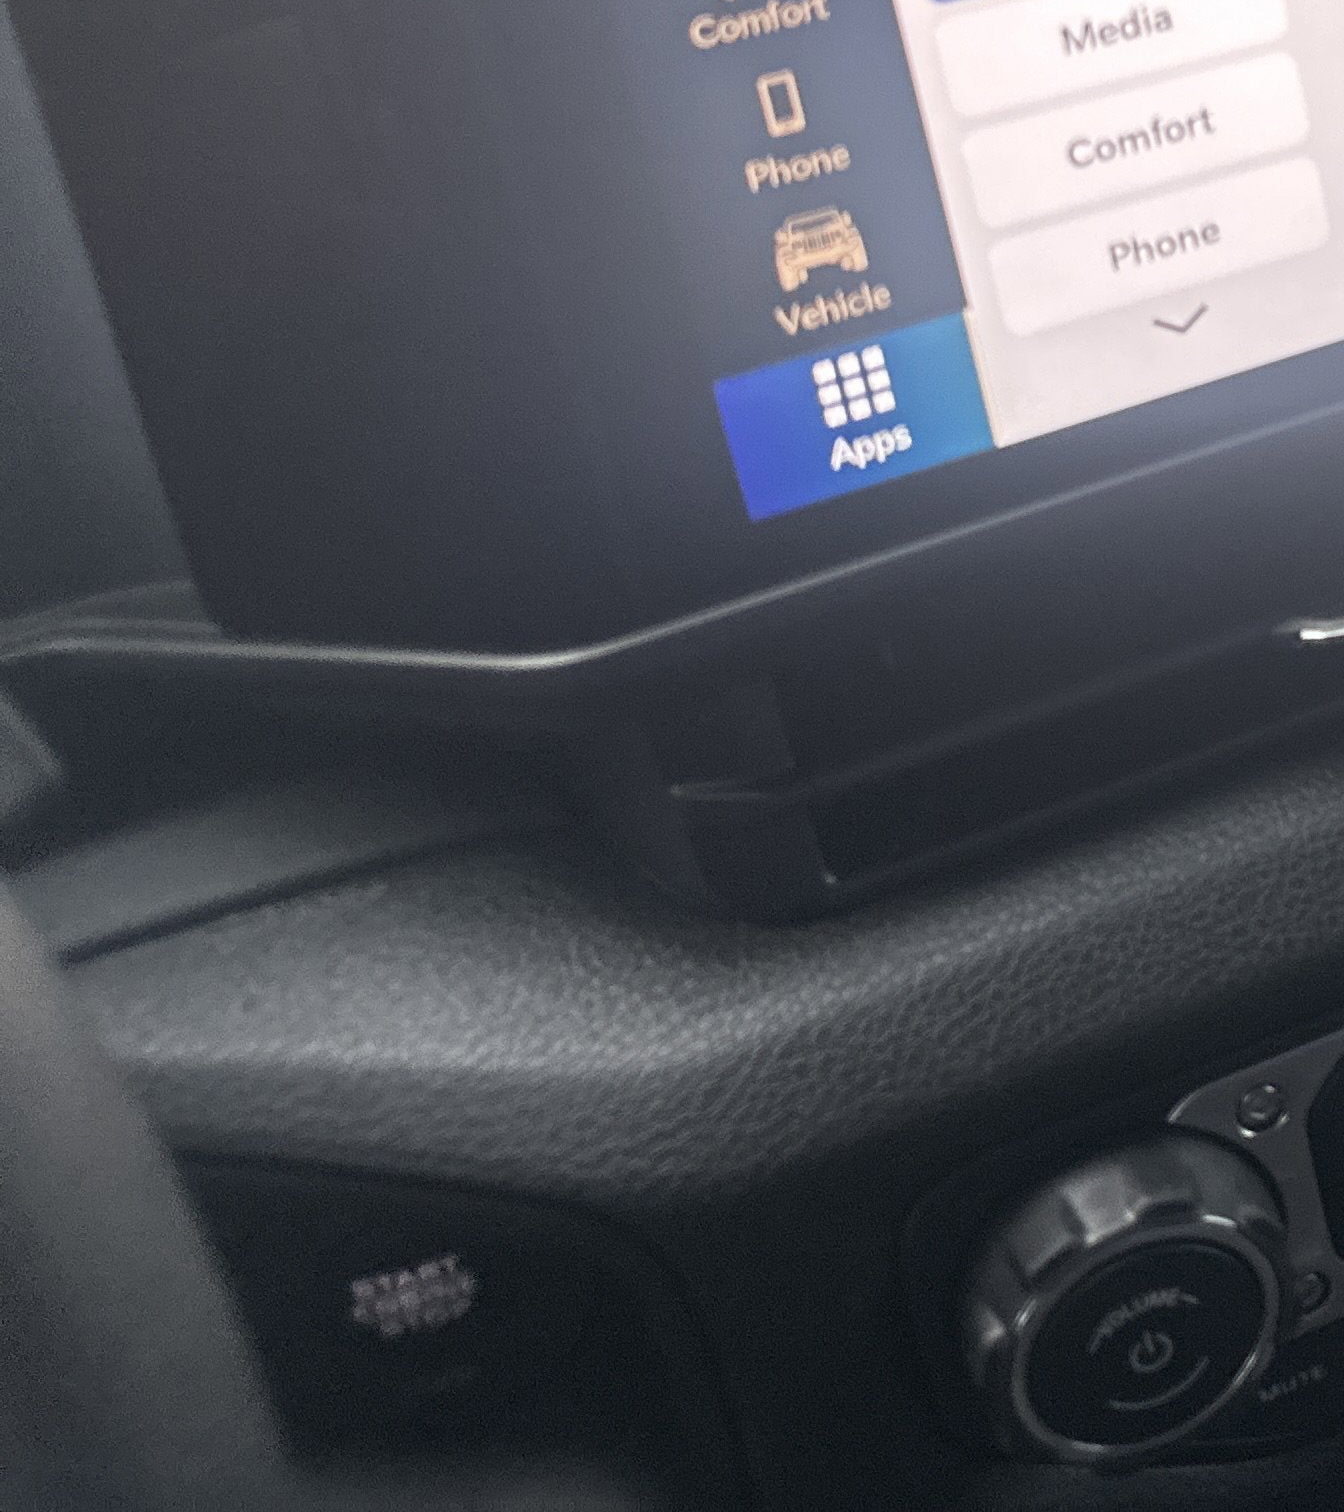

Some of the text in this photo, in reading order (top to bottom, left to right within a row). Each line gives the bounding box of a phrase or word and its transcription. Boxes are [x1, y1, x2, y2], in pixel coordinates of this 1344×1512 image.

[1060, 2, 1176, 58] Media
[1066, 104, 1218, 170] Comfort
[744, 142, 852, 194] Phone
[1107, 218, 1224, 274] Phone
[773, 280, 894, 338] Vehicle
[830, 422, 914, 472] Apps
